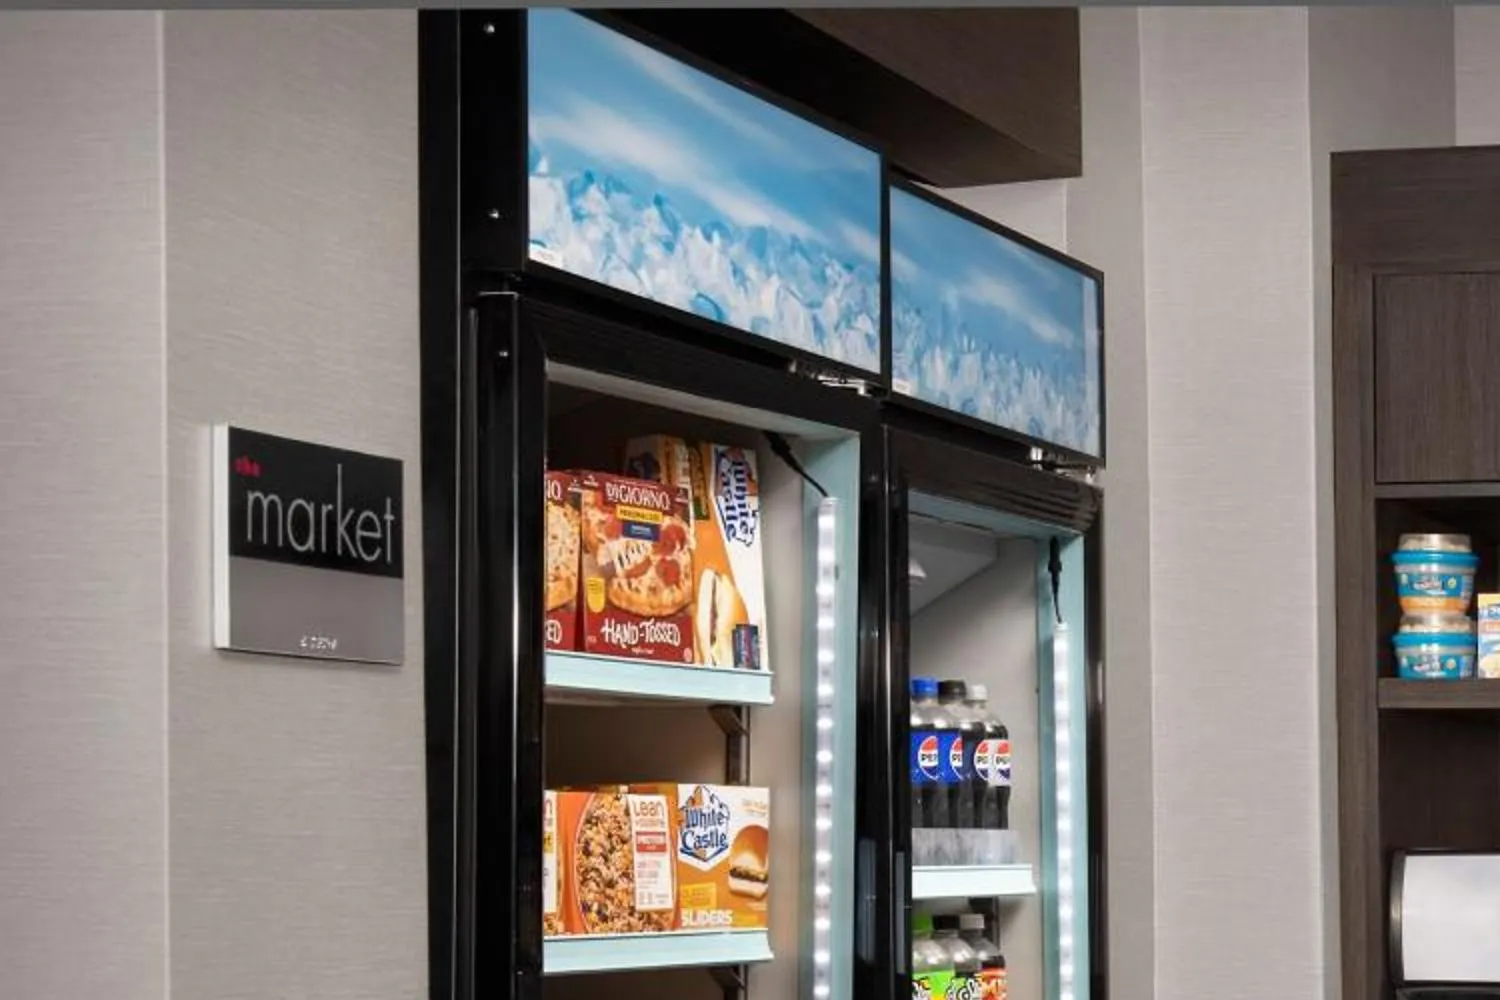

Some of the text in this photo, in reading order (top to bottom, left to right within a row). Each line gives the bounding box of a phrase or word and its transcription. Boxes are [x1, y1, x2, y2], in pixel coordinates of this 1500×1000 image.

[246, 463, 395, 564] market
[633, 801, 664, 818] Lean
[684, 803, 725, 829] White
[681, 831, 728, 851] Castle
[681, 909, 733, 926] SLIDERS
